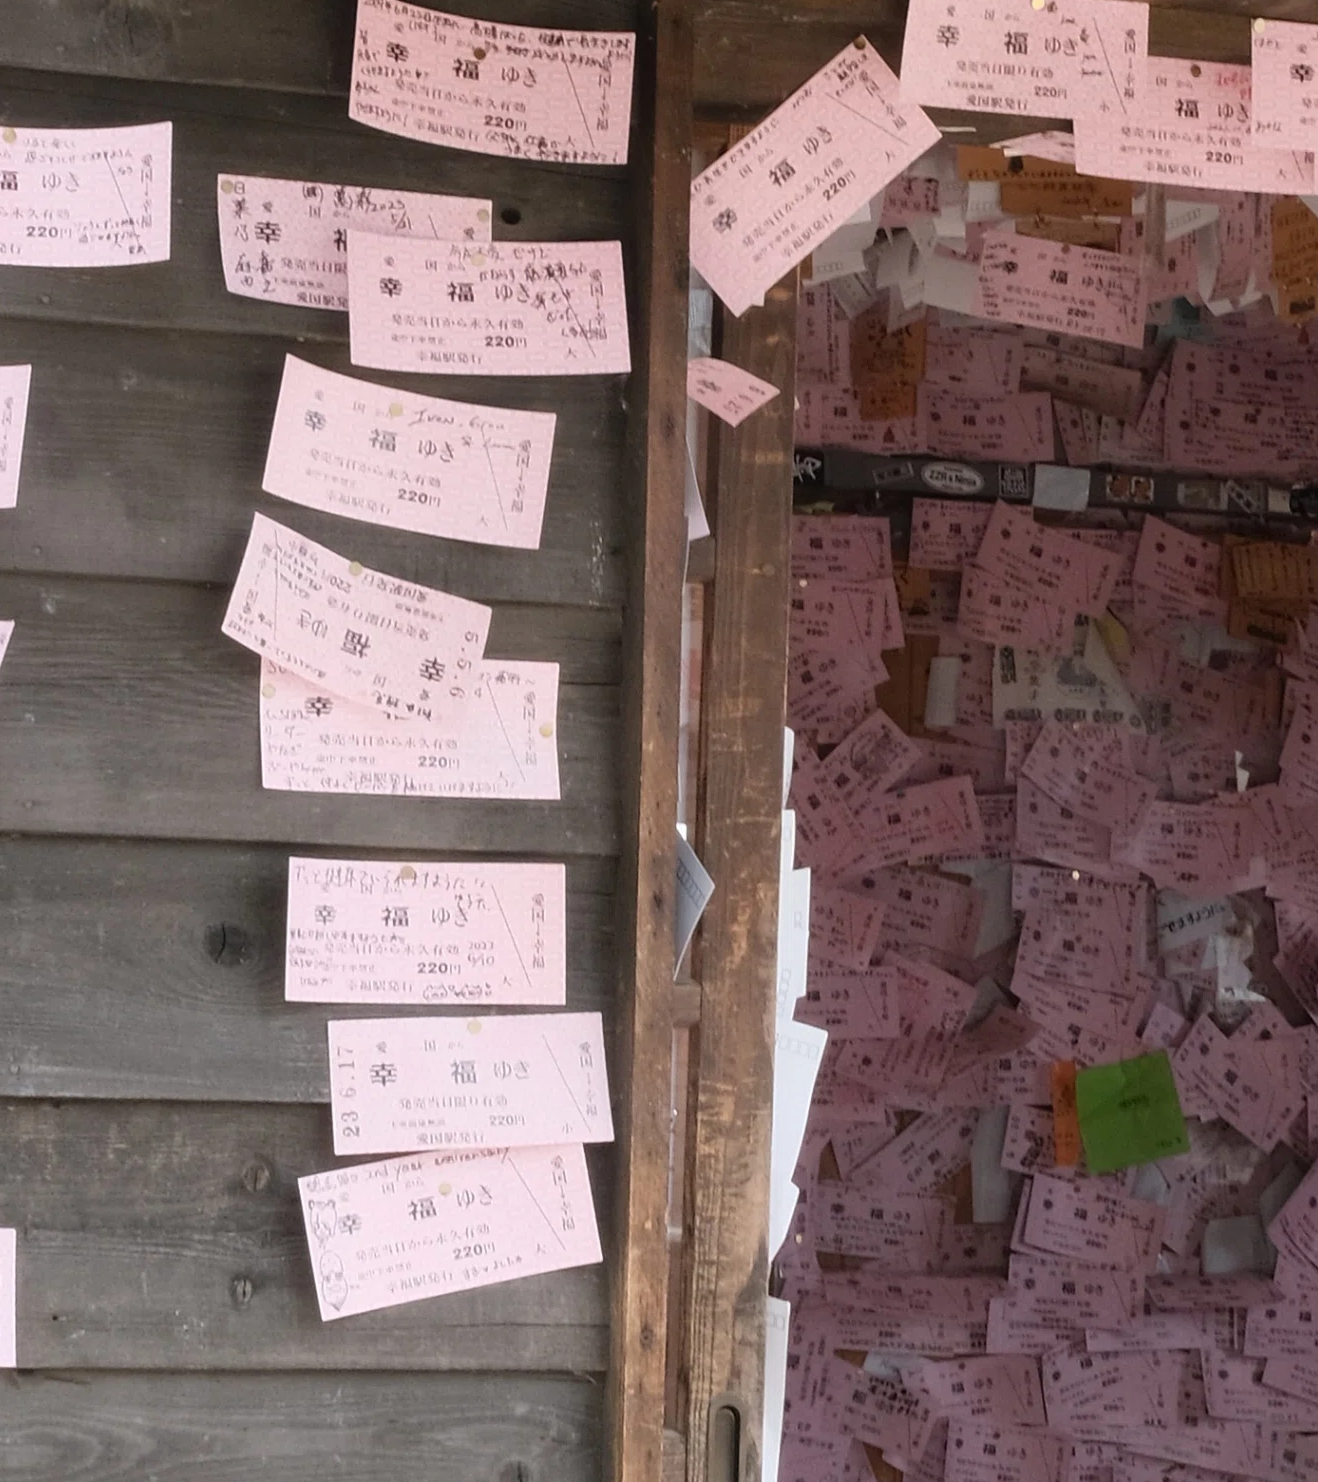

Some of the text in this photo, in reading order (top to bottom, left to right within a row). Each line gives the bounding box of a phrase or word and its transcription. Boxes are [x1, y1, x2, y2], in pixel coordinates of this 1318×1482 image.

[1034, 86, 1067, 98] 220円
[820, 167, 858, 202] 220円
[26, 225, 71, 238] 220円
[484, 335, 528, 347] 220円
[396, 487, 441, 508] 220円
[417, 756, 459, 768] 220円
[417, 962, 460, 975] 220円
[489, 1113, 525, 1126] 220円
[452, 1239, 496, 1261] 220円
